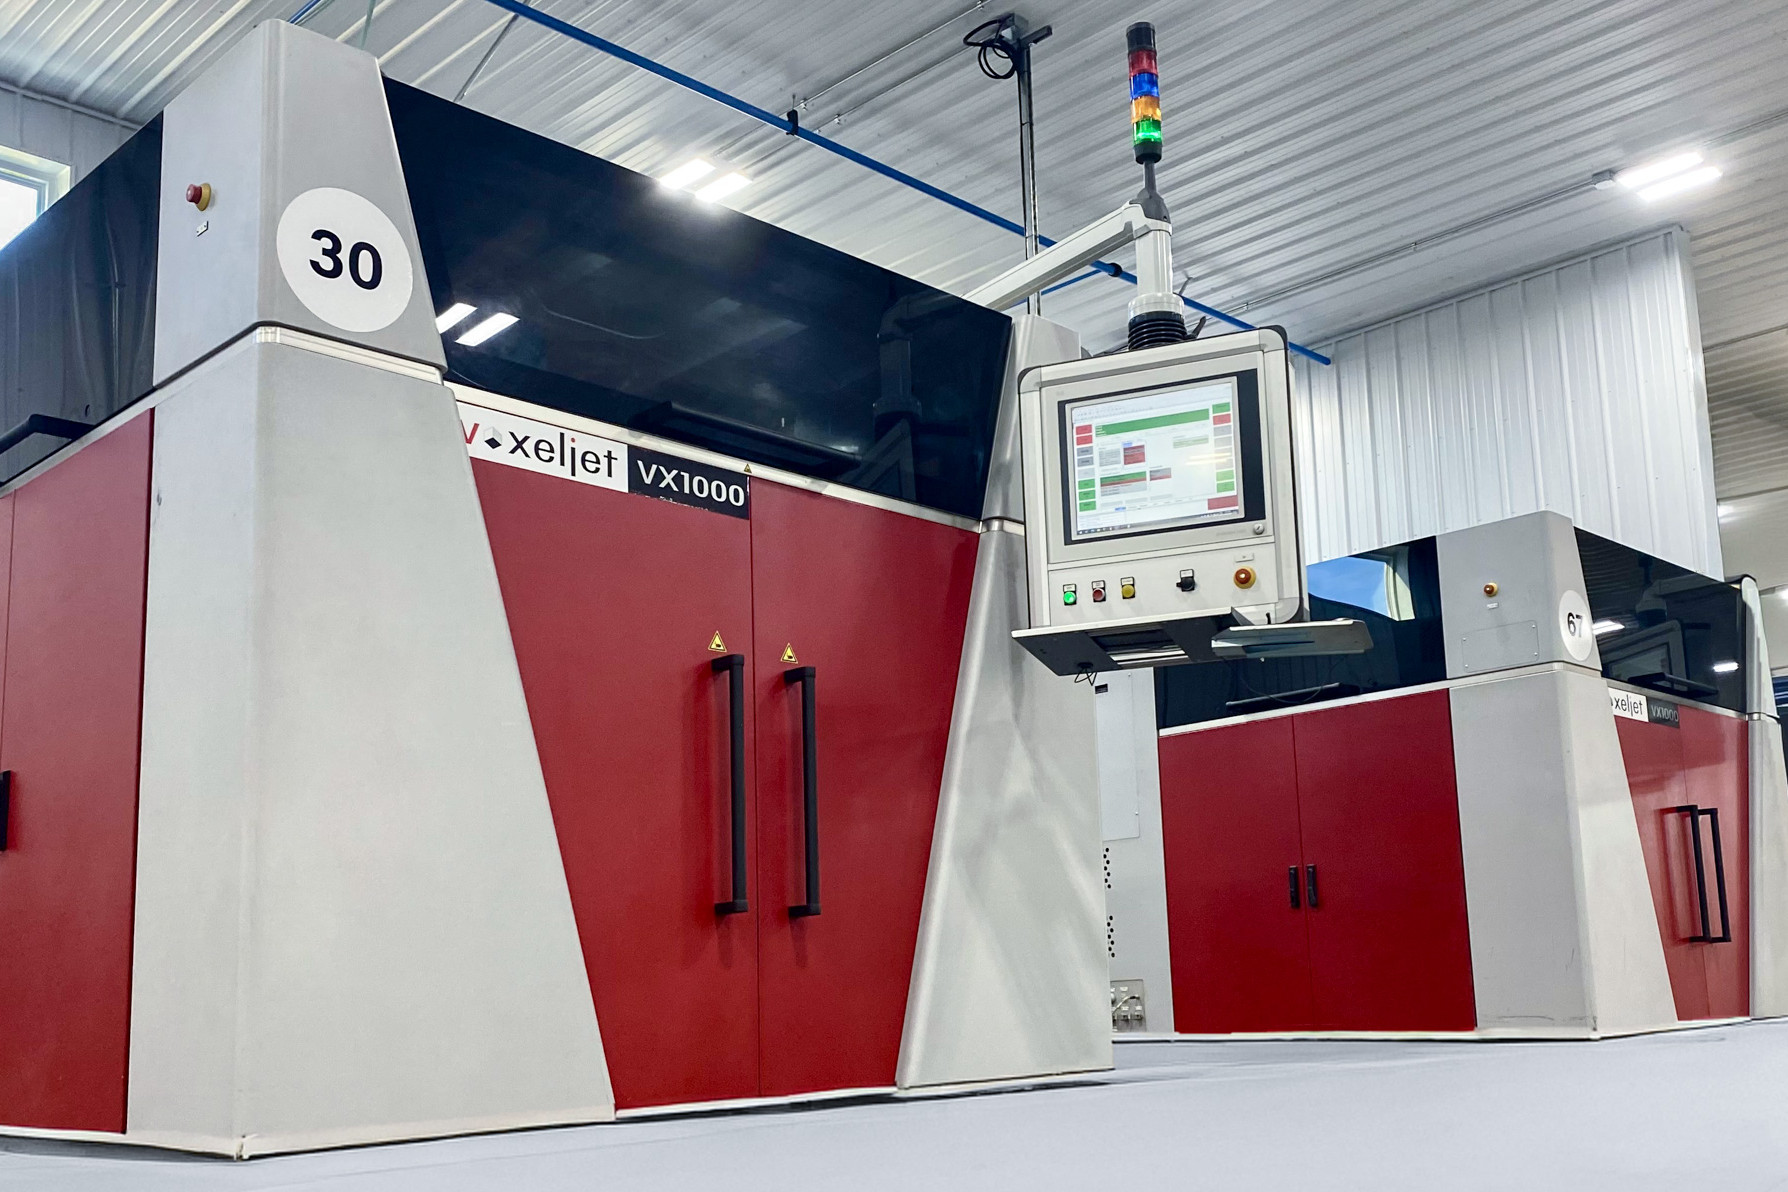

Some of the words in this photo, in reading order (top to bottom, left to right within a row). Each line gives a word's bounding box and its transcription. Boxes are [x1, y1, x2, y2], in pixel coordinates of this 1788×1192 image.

[309, 229, 383, 291] 30
[637, 459, 745, 507] VX1000
[1567, 611, 1583, 638] 67
[1611, 694, 1643, 717] xeljet
[1651, 705, 1679, 722] VX1000
